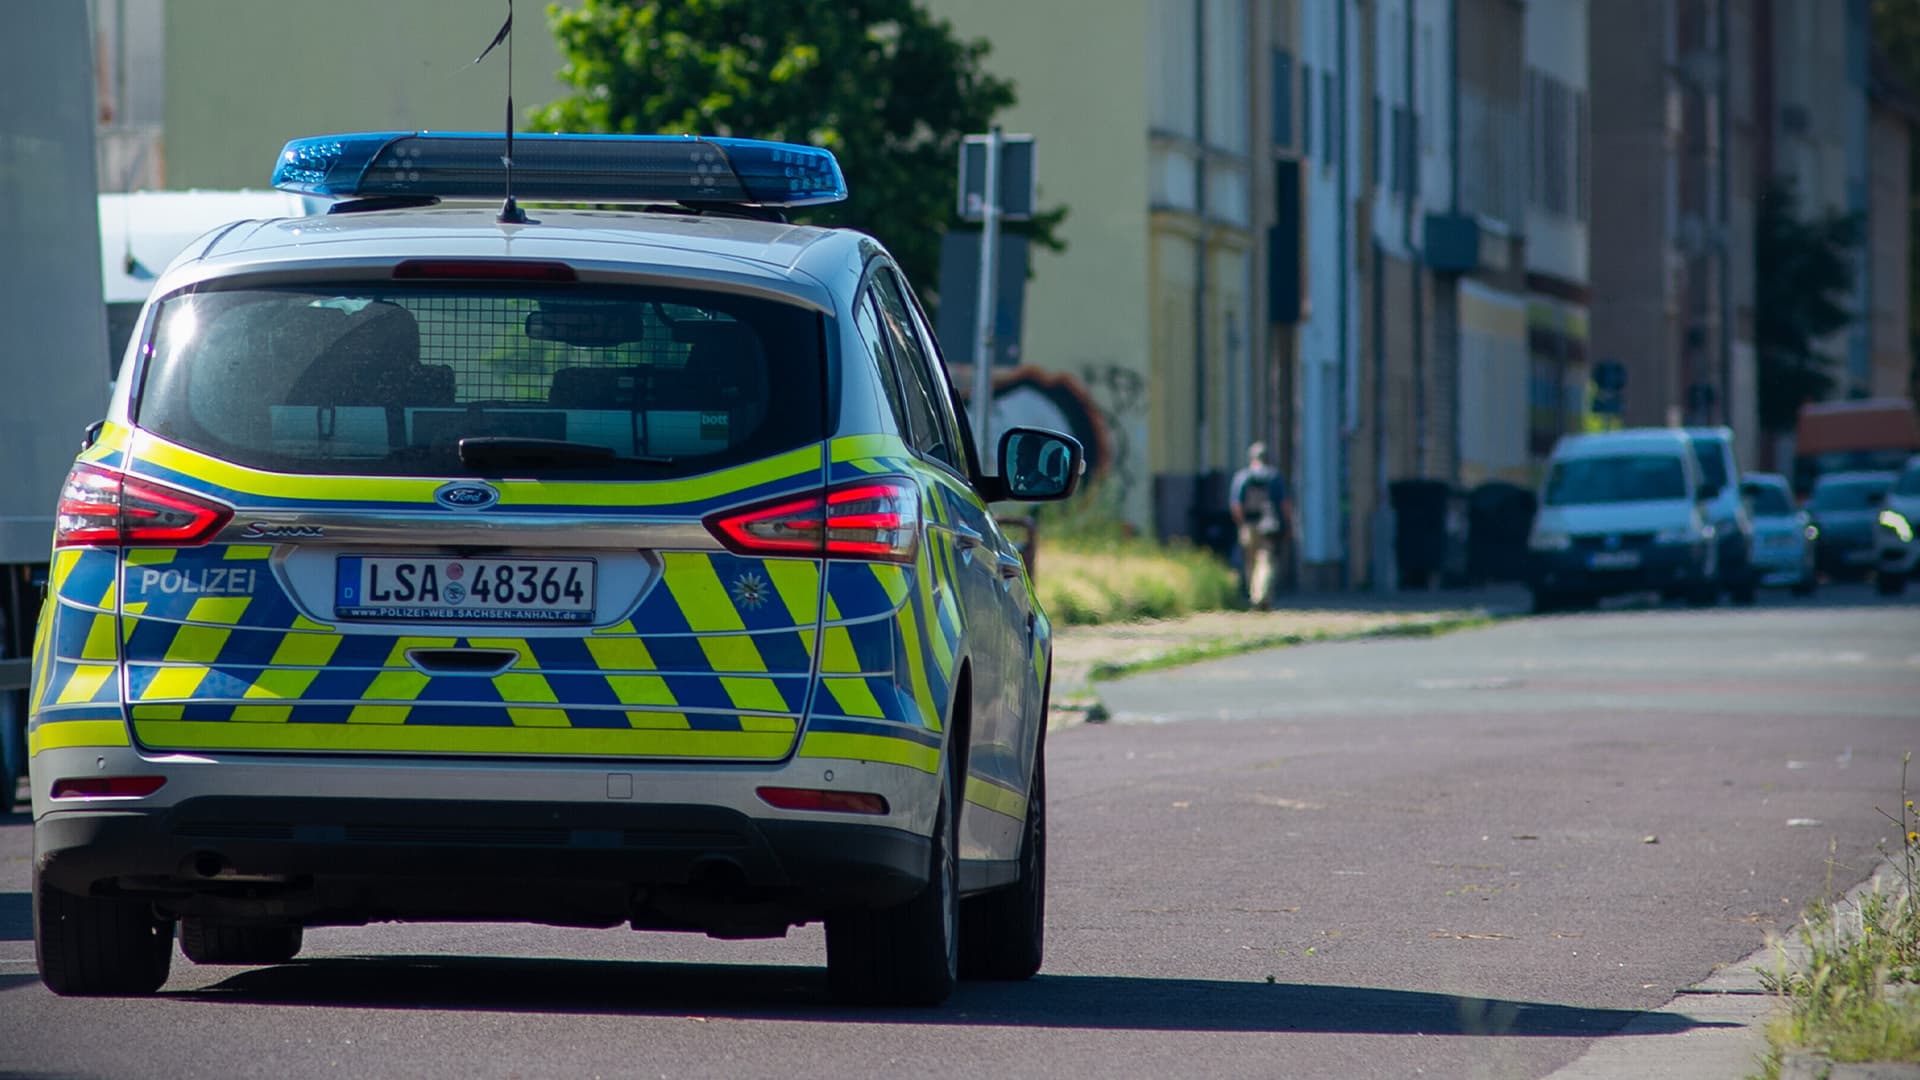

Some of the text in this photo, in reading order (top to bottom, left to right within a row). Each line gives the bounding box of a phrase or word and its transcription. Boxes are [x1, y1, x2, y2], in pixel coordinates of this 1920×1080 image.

[450, 489, 482, 502] Ford
[141, 568, 256, 593] POLIZEI
[369, 563, 584, 604] LSA 48364
[344, 587, 354, 598] D
[351, 607, 577, 620] www.POLIZEI-WEB.SACHSEN-ANHALT.de
